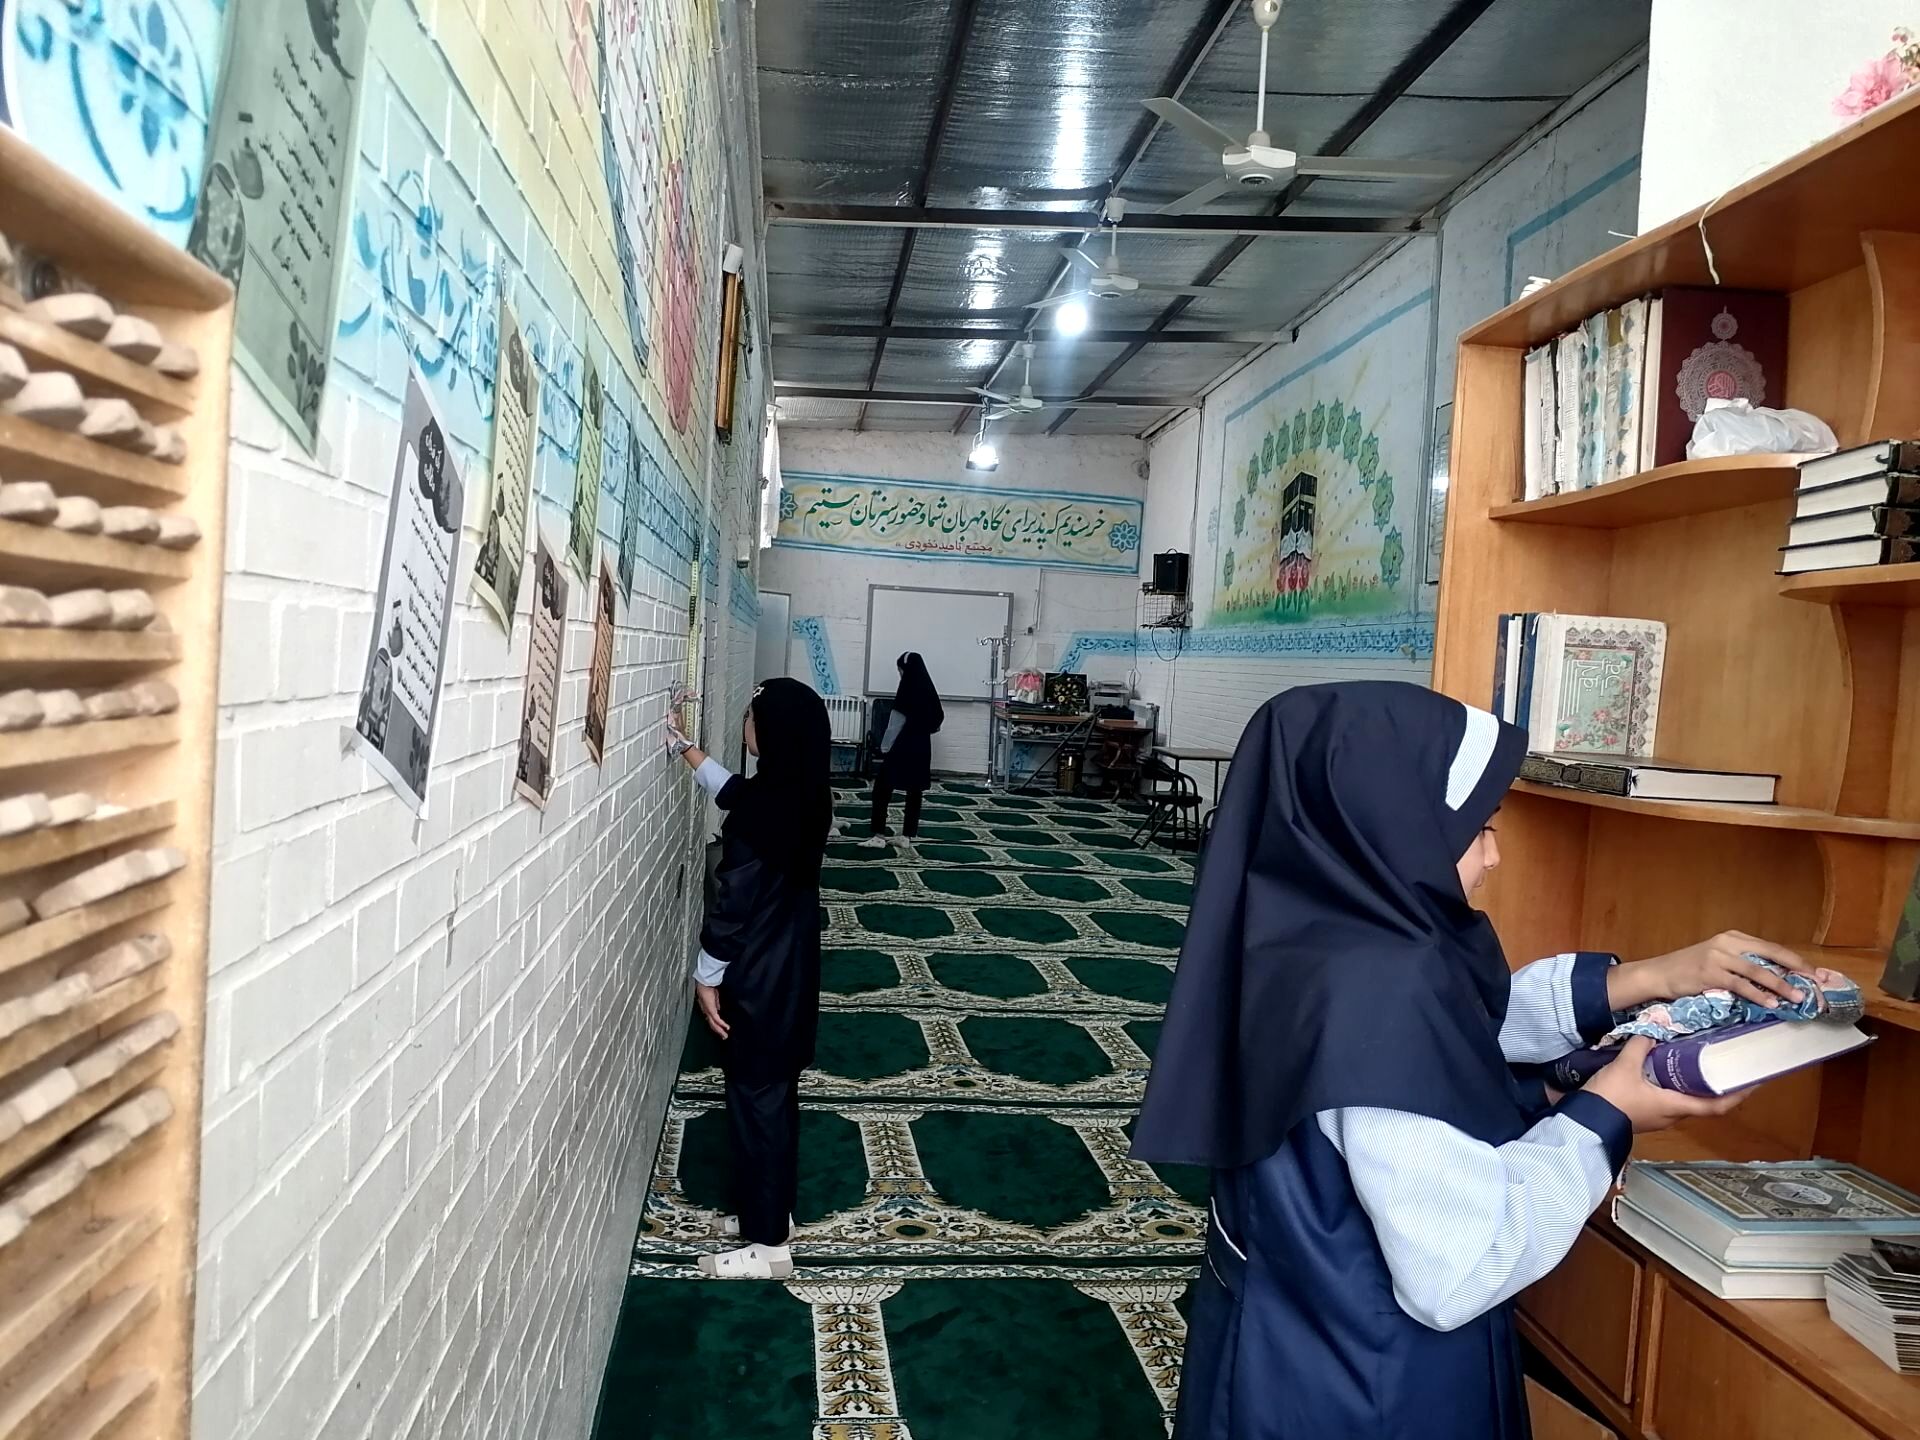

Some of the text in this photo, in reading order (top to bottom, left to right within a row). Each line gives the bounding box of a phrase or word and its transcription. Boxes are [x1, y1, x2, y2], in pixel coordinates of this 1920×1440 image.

[802, 487, 862, 536] هستیم
[849, 489, 900, 533] سبزتان
[887, 496, 925, 526] حضور
[927, 496, 948, 528] شما
[942, 501, 986, 542] مهربان
[983, 503, 1011, 531] نگاه
[1046, 504, 1074, 534] که
[1056, 508, 1106, 546] خرسندیم
[1002, 507, 1047, 550] پذیرای
[904, 539, 938, 552] نخودی
[965, 542, 993, 554] مجتمع
